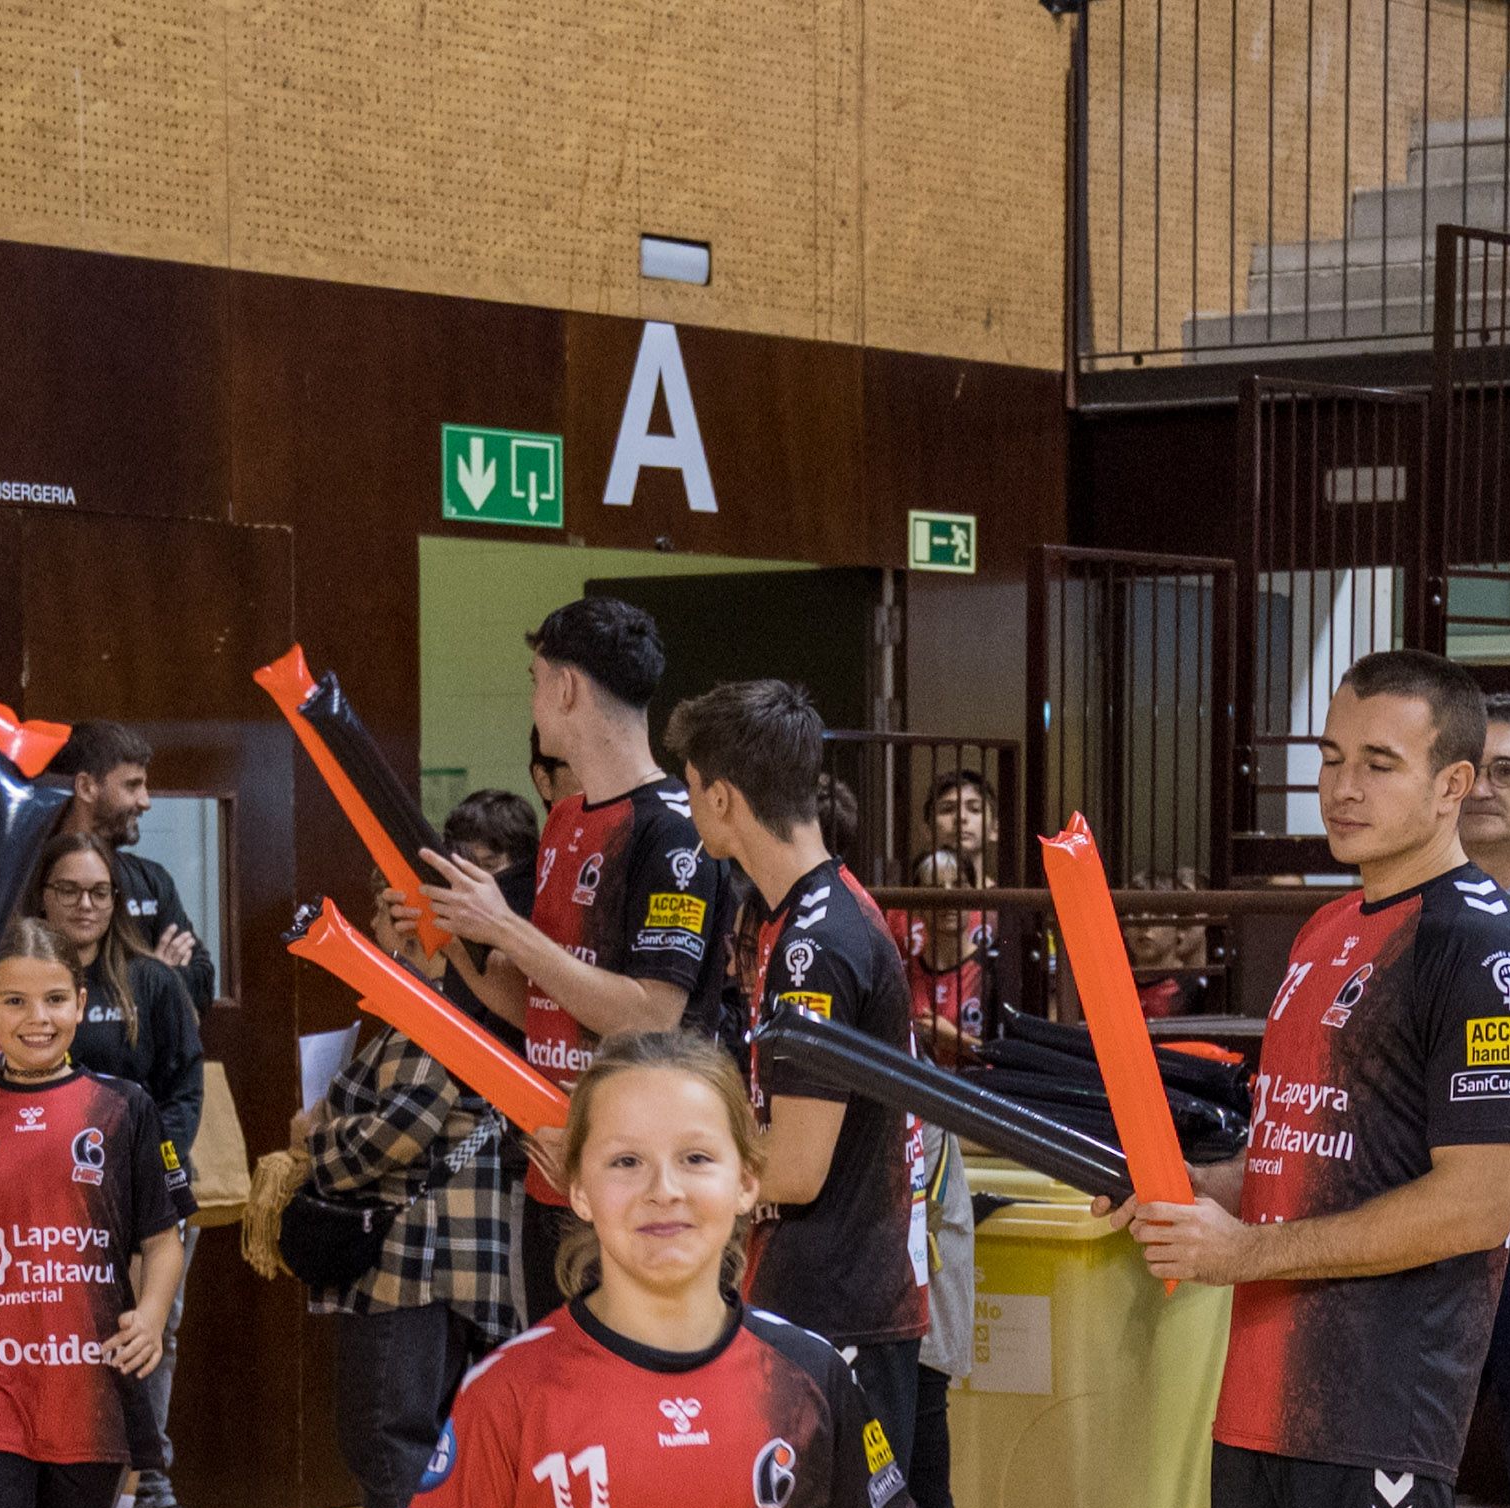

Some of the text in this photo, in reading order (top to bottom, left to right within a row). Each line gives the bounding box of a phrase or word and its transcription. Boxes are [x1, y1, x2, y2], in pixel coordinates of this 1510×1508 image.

[603, 321, 719, 513] A
[1272, 1074, 1348, 1115] Lapeyra
[1262, 1120, 1353, 1161] Taltavull
[658, 1429, 710, 1448] hummel
